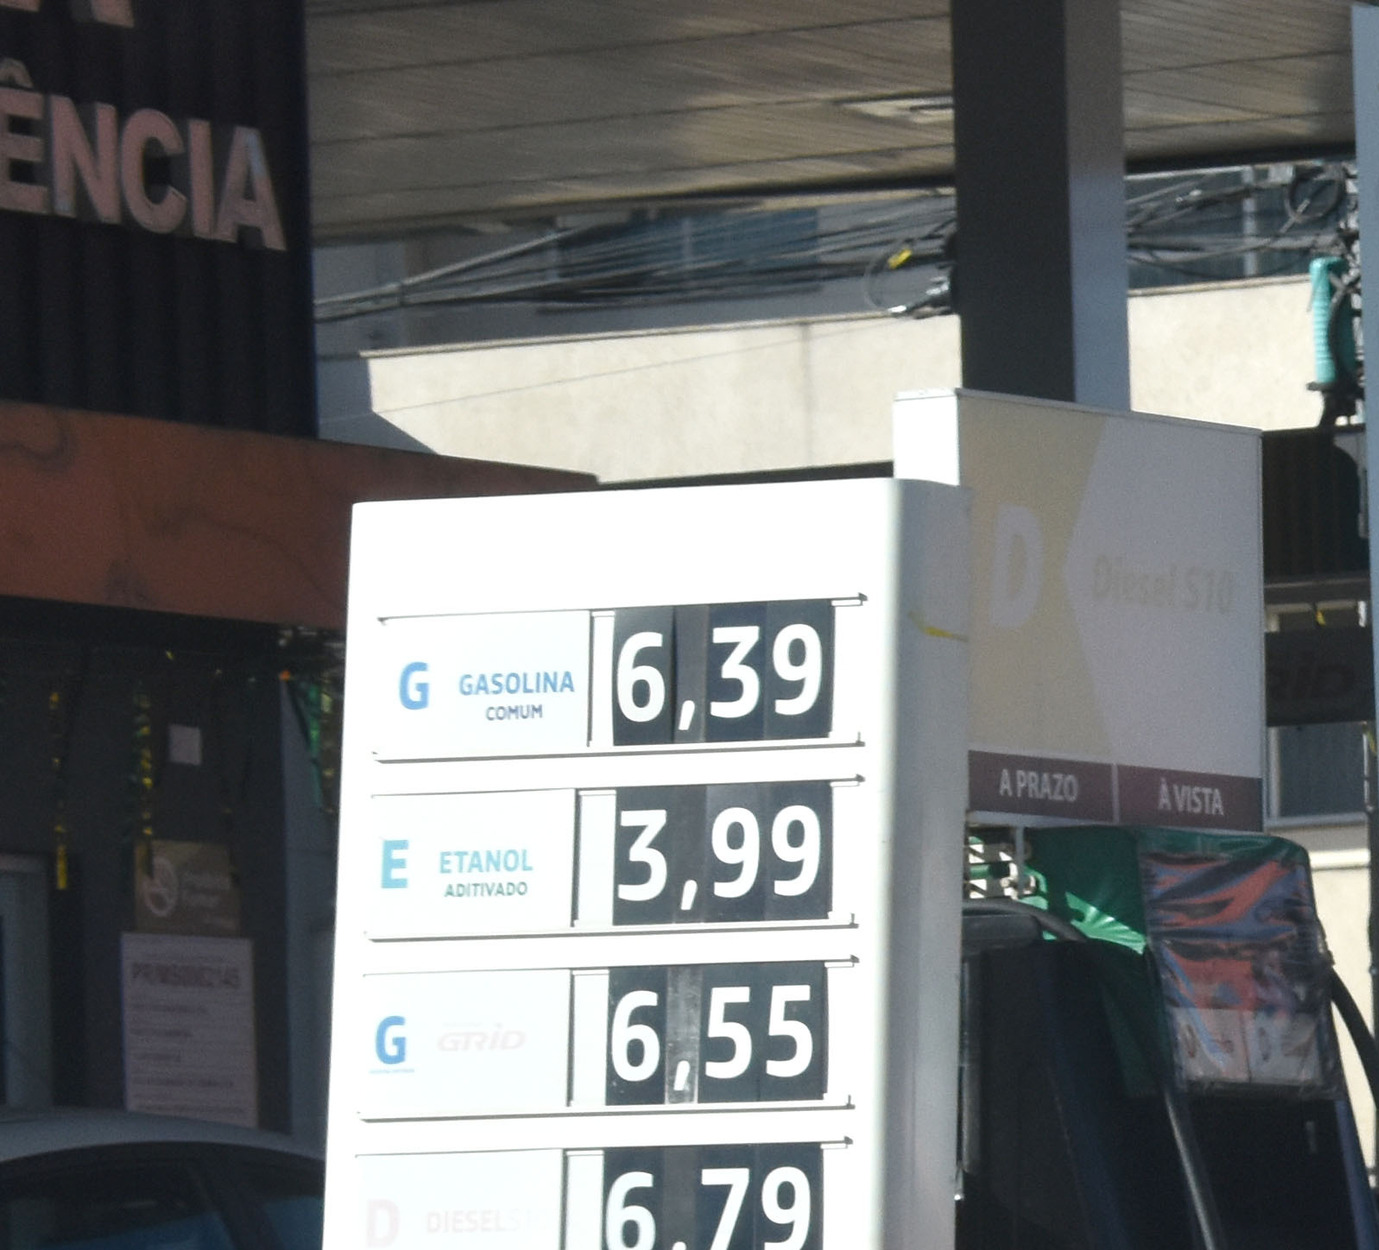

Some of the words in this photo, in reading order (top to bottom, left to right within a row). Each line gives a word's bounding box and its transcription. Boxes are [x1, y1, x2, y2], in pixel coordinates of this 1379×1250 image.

[990, 503, 1044, 629] D
[400, 661, 430, 710] G
[458, 670, 575, 698] GASOLINA
[616, 622, 824, 731] 6,39
[485, 703, 543, 722] COMUM
[1000, 767, 1013, 796] A
[1016, 766, 1079, 803] PRAZO
[1175, 783, 1225, 817] VISTA
[380, 839, 410, 889] E
[439, 848, 534, 875] ETANOL
[616, 804, 822, 911] 3,99
[443, 881, 529, 899] ADITIVADO
[375, 1015, 407, 1064] G
[610, 983, 815, 1092] 6,55
[366, 1199, 400, 1249] D
[425, 1209, 507, 1235] DIESEL
